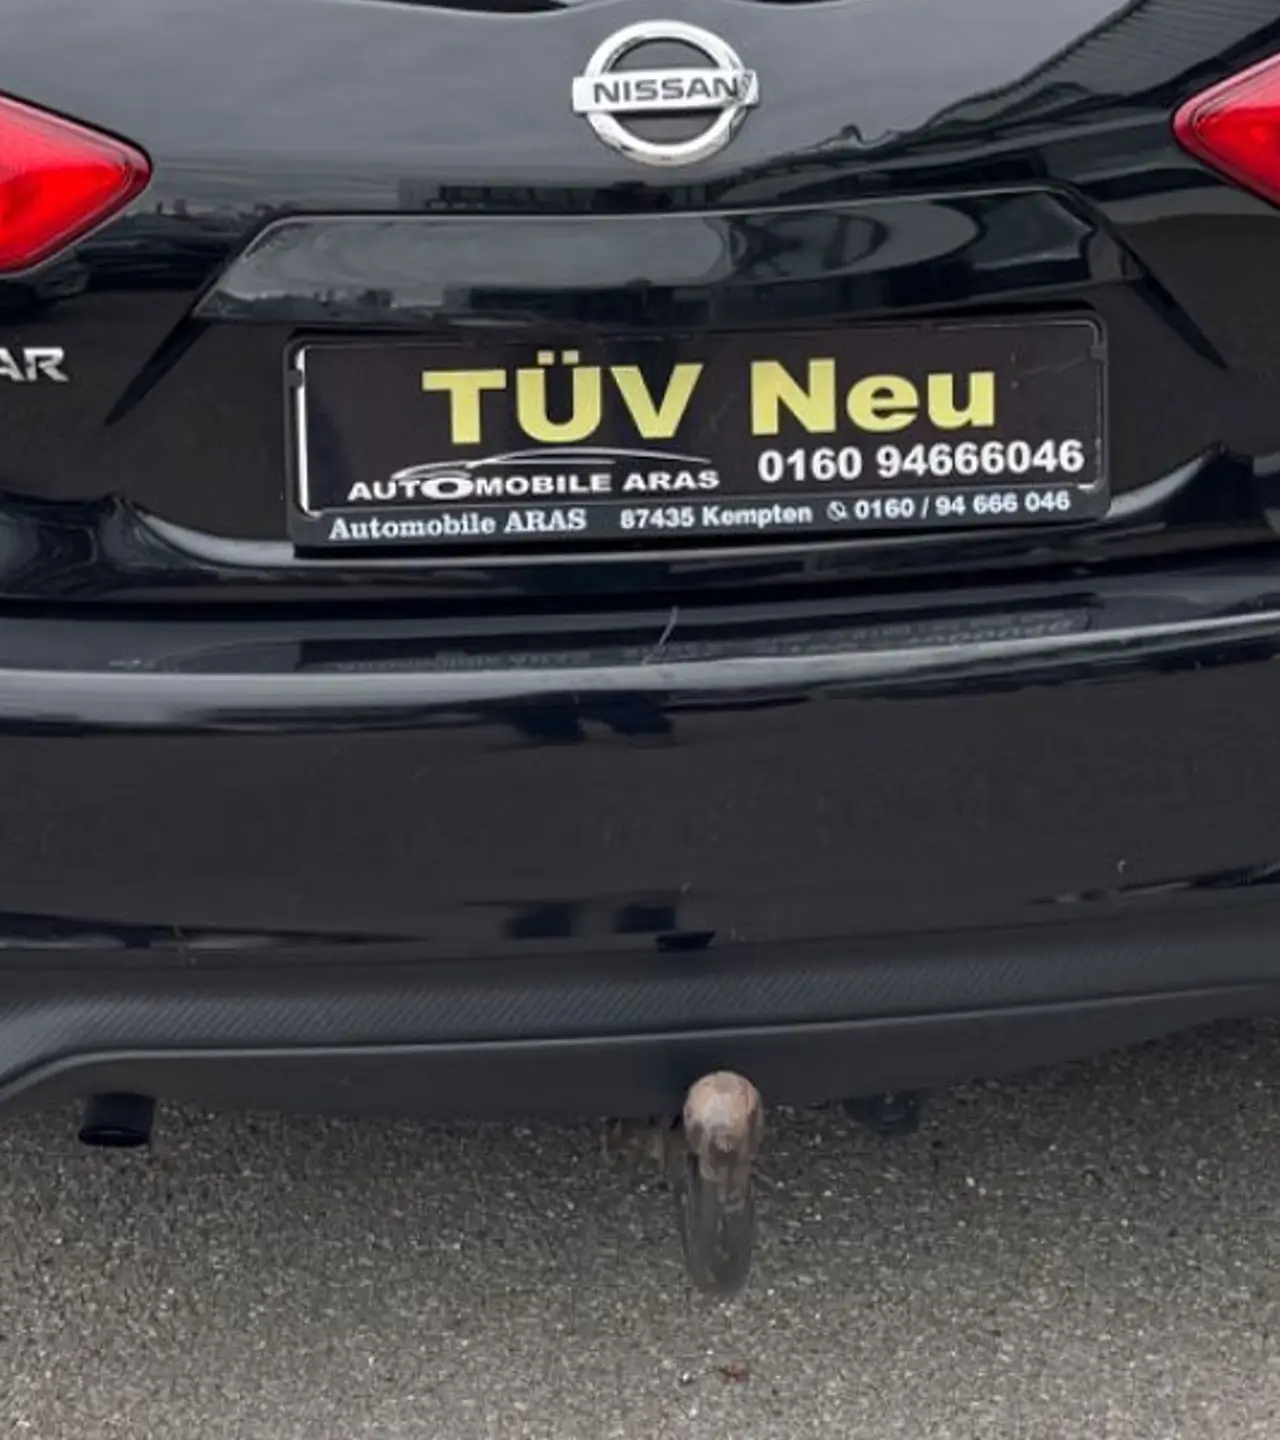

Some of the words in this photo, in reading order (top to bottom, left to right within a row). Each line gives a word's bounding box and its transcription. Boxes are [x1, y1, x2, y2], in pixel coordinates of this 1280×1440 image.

[593, 76, 738, 104] NISSAN
[422, 350, 704, 444] TÜV
[750, 357, 996, 436] Neu
[757, 446, 863, 483] 0160
[876, 438, 1085, 479] 94666046
[347, 471, 612, 501] AUTOMOBILE
[622, 469, 720, 492] ARAS
[328, 512, 497, 541] Automobile
[503, 508, 588, 533] ARAS
[619, 507, 695, 530] 87435
[701, 503, 813, 530] Kempten
[853, 497, 915, 520] 0160
[935, 494, 965, 517] 94
[972, 492, 1019, 515] 666
[1024, 490, 1071, 513] 046
